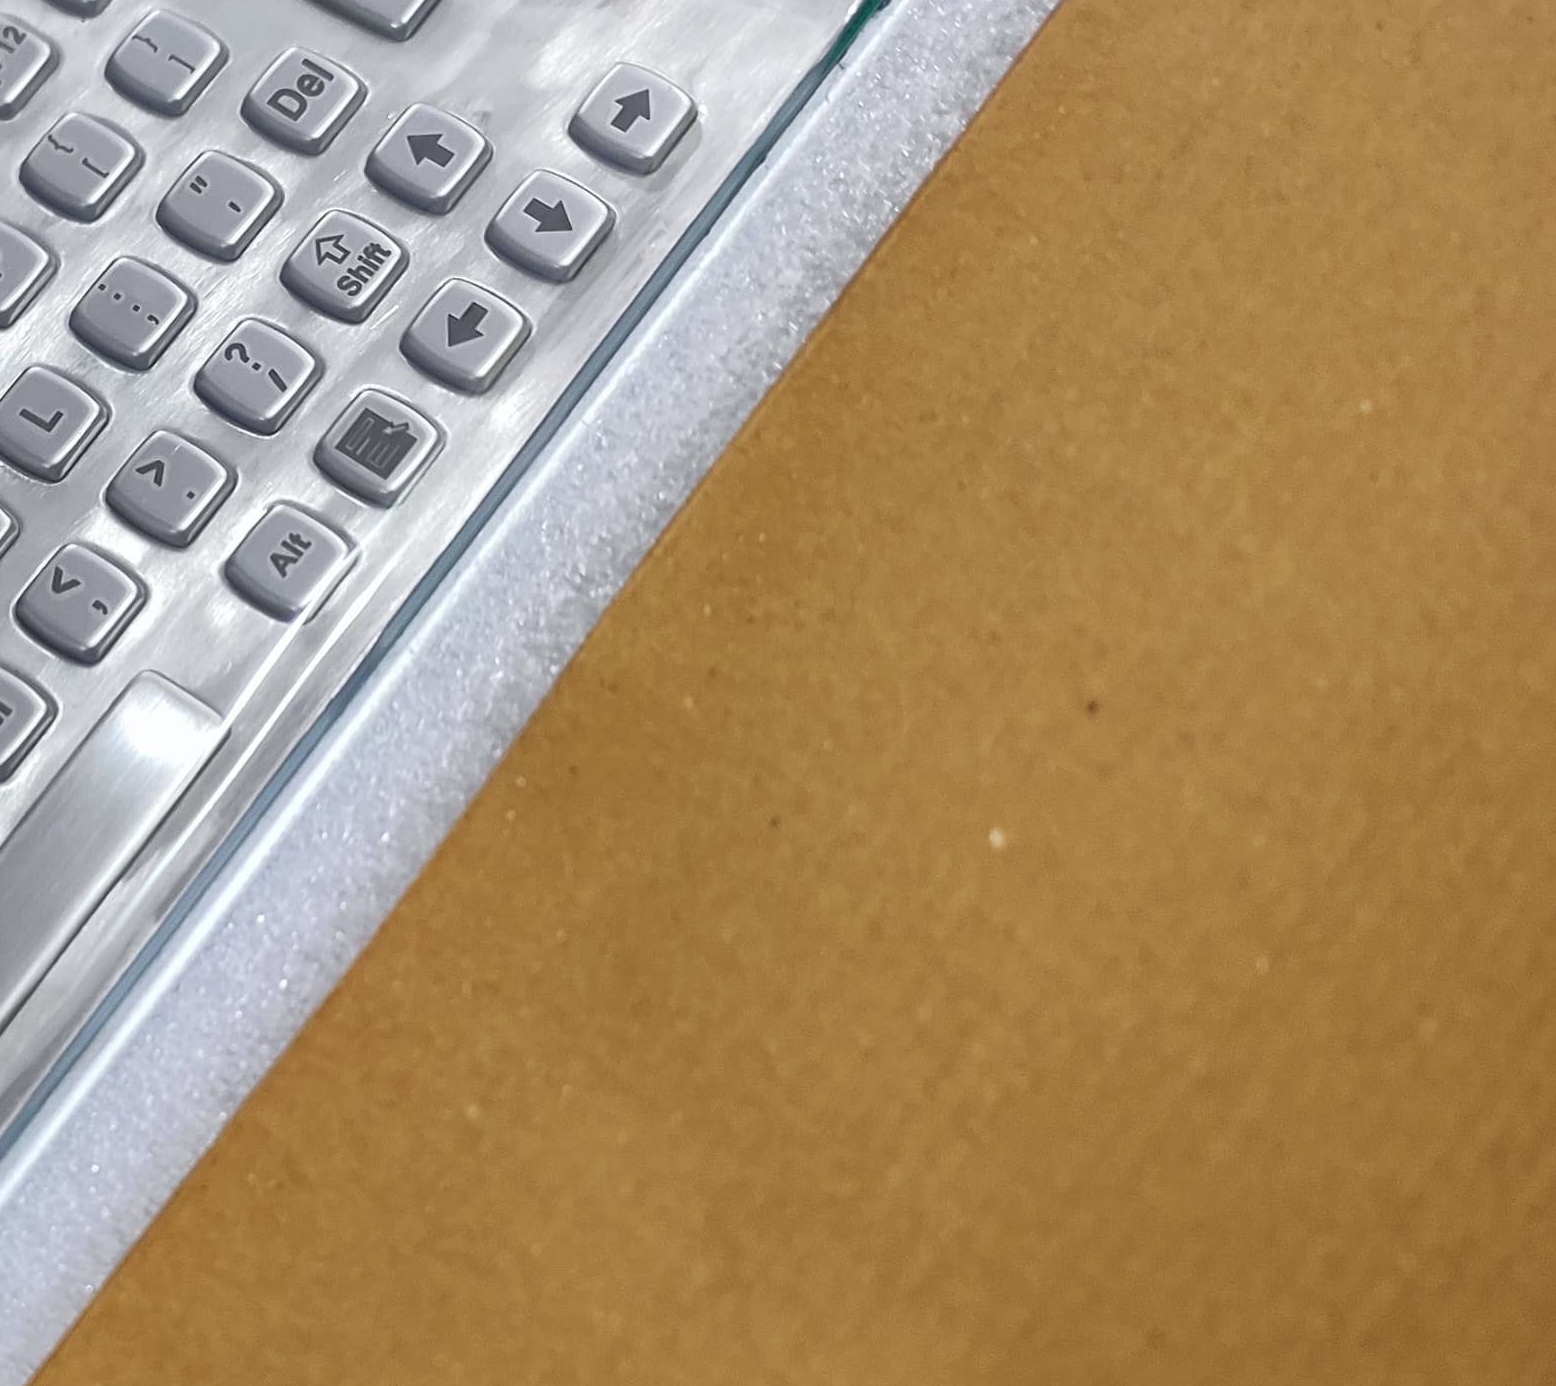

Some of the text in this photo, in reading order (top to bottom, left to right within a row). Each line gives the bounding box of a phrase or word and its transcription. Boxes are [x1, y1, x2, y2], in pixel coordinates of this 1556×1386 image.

[266, 58, 334, 122] Del
[337, 242, 392, 296] Shift
[19, 408, 64, 433] L
[270, 532, 312, 578] Alt
